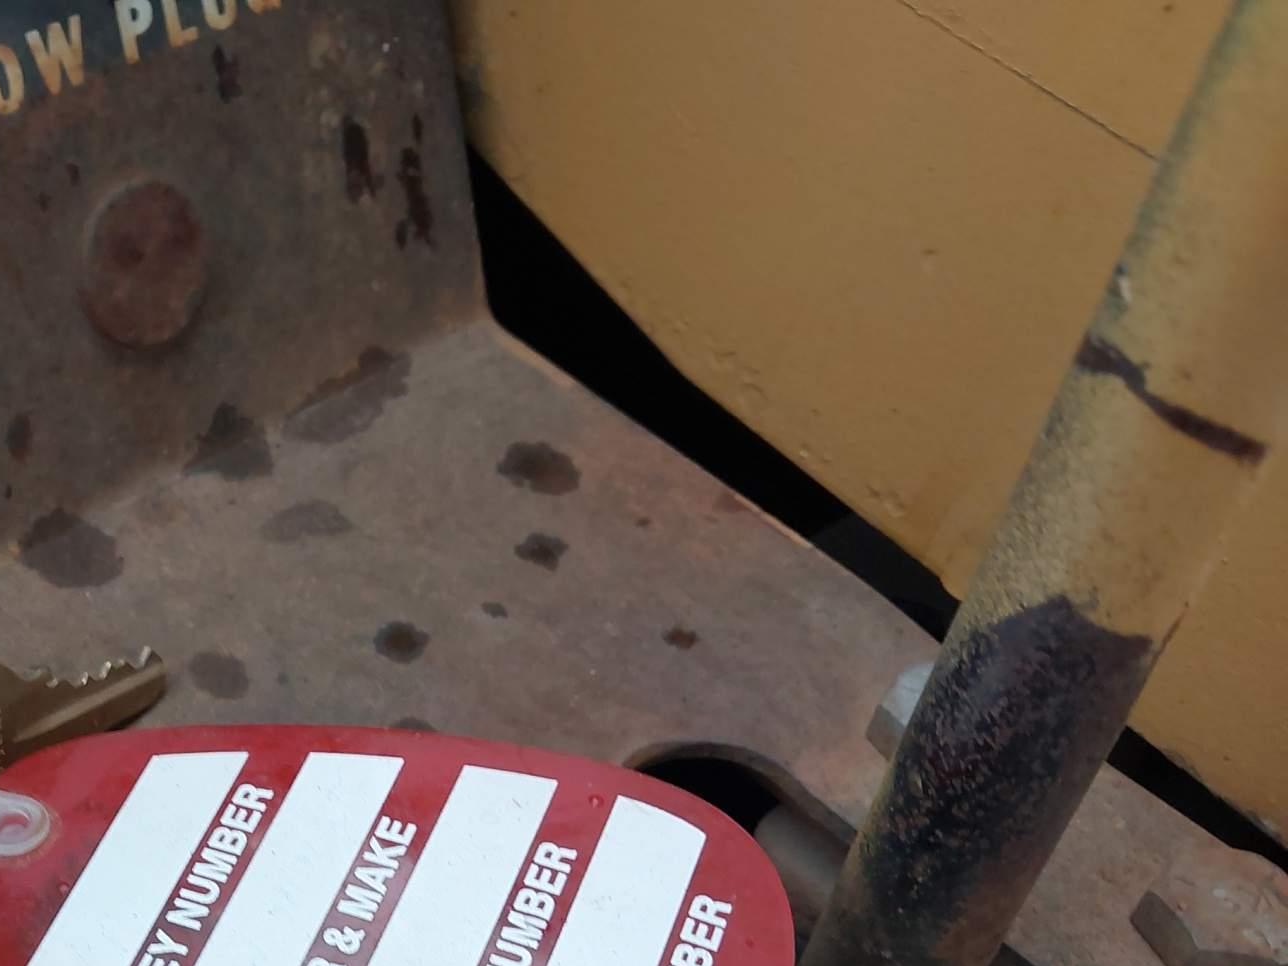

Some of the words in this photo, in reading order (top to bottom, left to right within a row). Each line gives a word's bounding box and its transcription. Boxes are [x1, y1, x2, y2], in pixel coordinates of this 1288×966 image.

[116, 0, 281, 65] PL
[165, 783, 274, 931] NUMBER
[336, 815, 417, 922] MAKE
[323, 926, 365, 955] &
